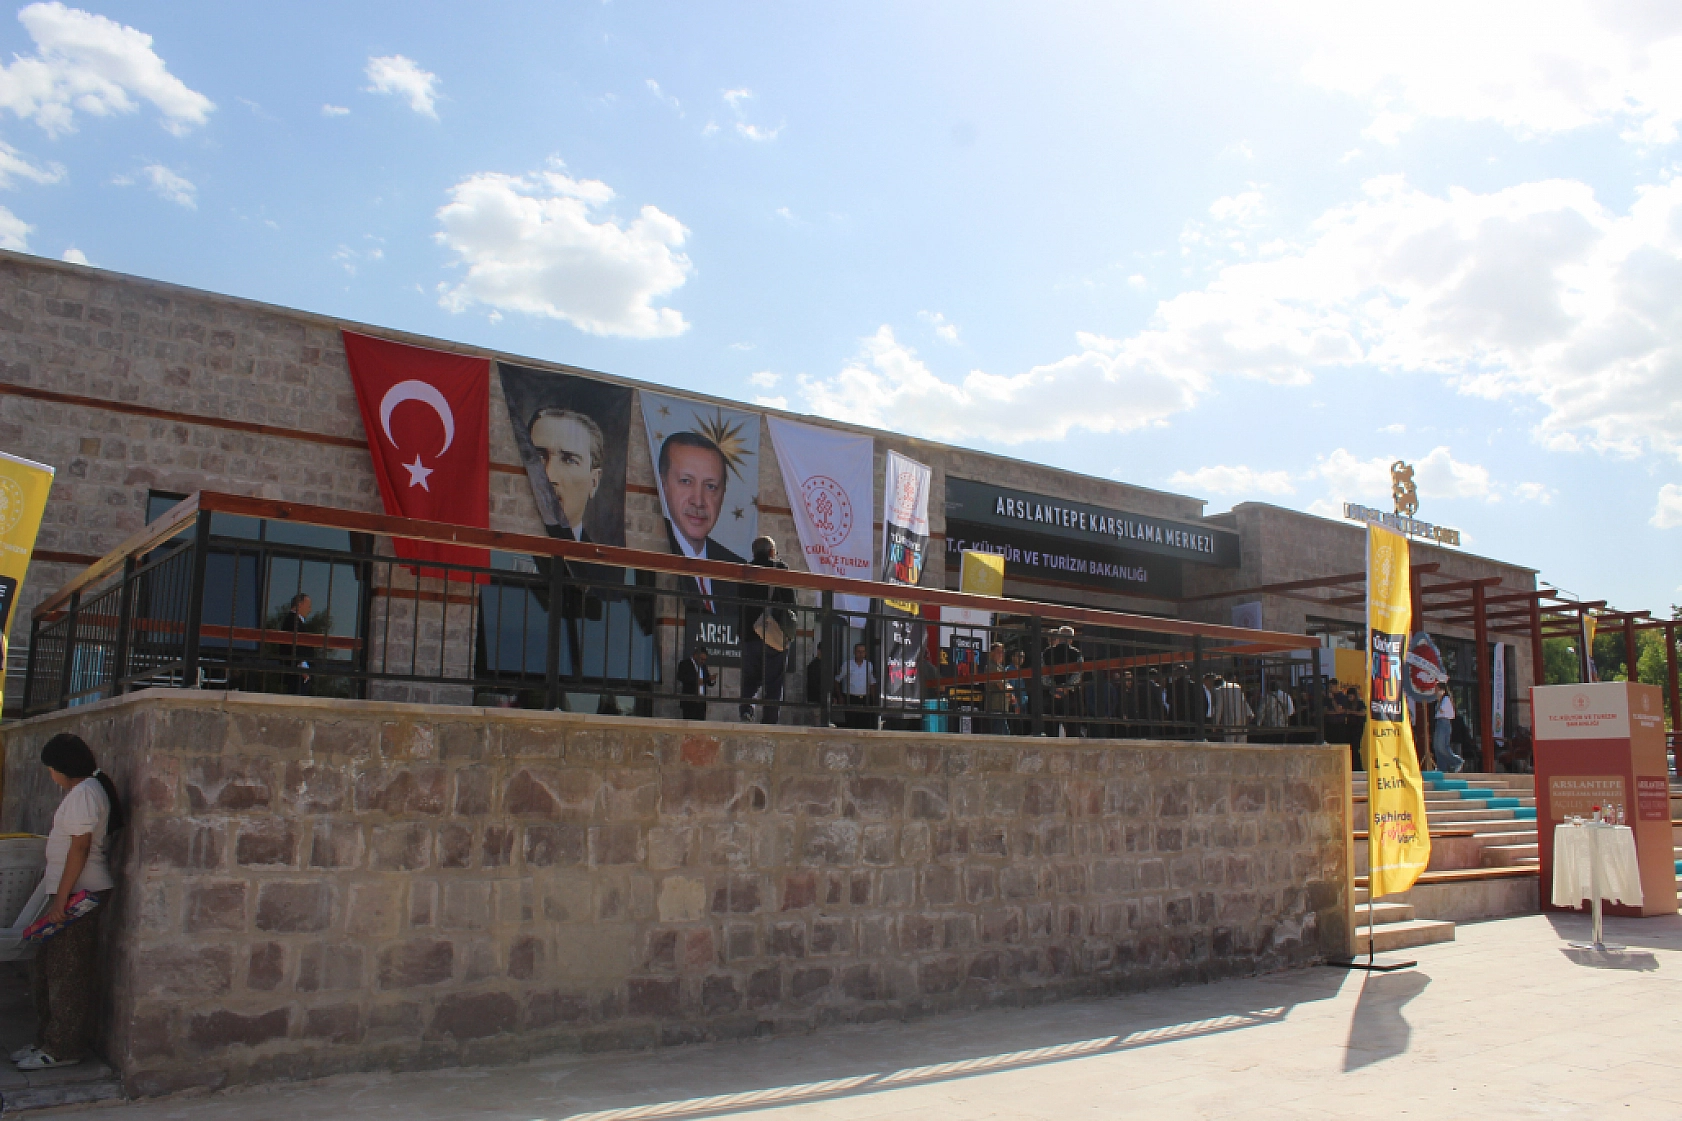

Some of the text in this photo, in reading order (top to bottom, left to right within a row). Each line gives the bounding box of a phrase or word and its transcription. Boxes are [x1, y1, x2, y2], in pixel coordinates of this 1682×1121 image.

[996, 496, 1214, 554] ARSLANTEPE KARŞILAMA MERKEZİ
[1023, 550, 1038, 566] VE
[1042, 553, 1087, 573] TURİZM
[1090, 561, 1148, 582] BAKANLIĞI
[1552, 780, 1622, 789] ARSLANTEPE
[1374, 810, 1412, 825] Şehirde
